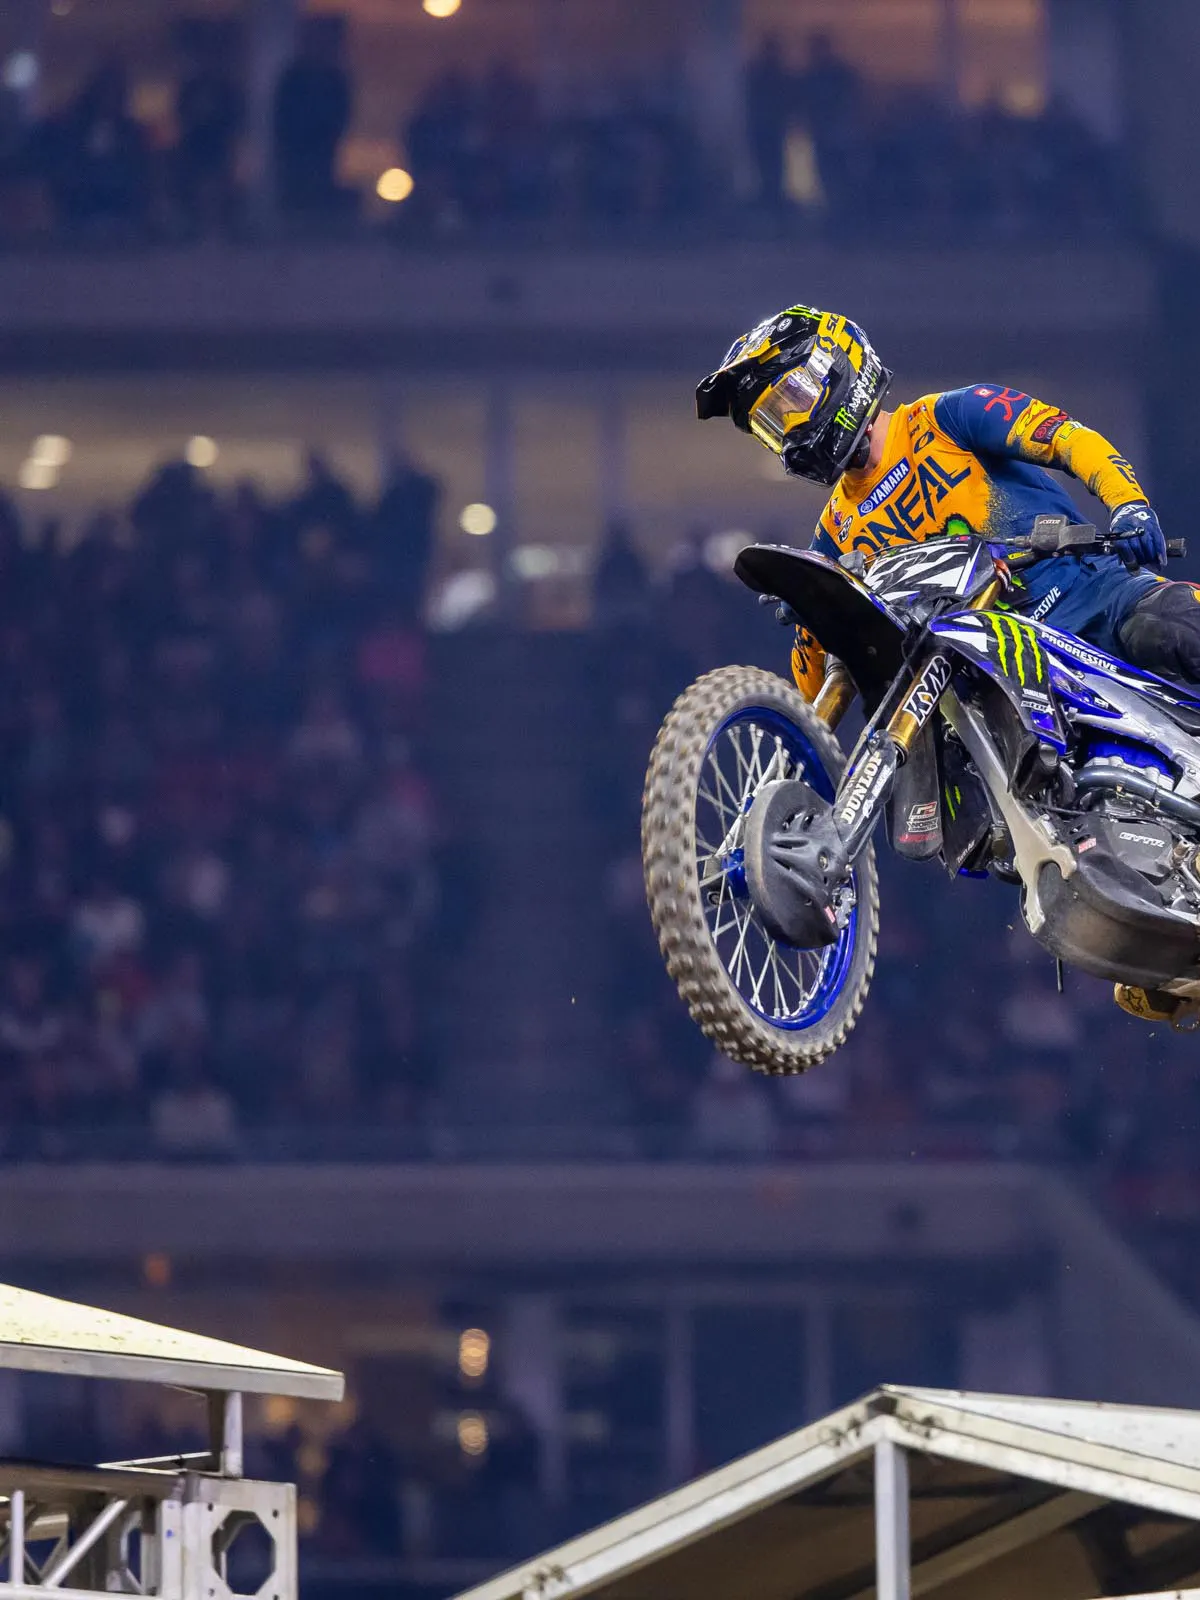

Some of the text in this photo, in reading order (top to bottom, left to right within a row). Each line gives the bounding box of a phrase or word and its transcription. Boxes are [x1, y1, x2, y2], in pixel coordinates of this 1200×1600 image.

[870, 461, 910, 505] YAMAHA
[1041, 631, 1118, 673] PROGRESSIVE
[841, 751, 884, 825] DUNLOP
